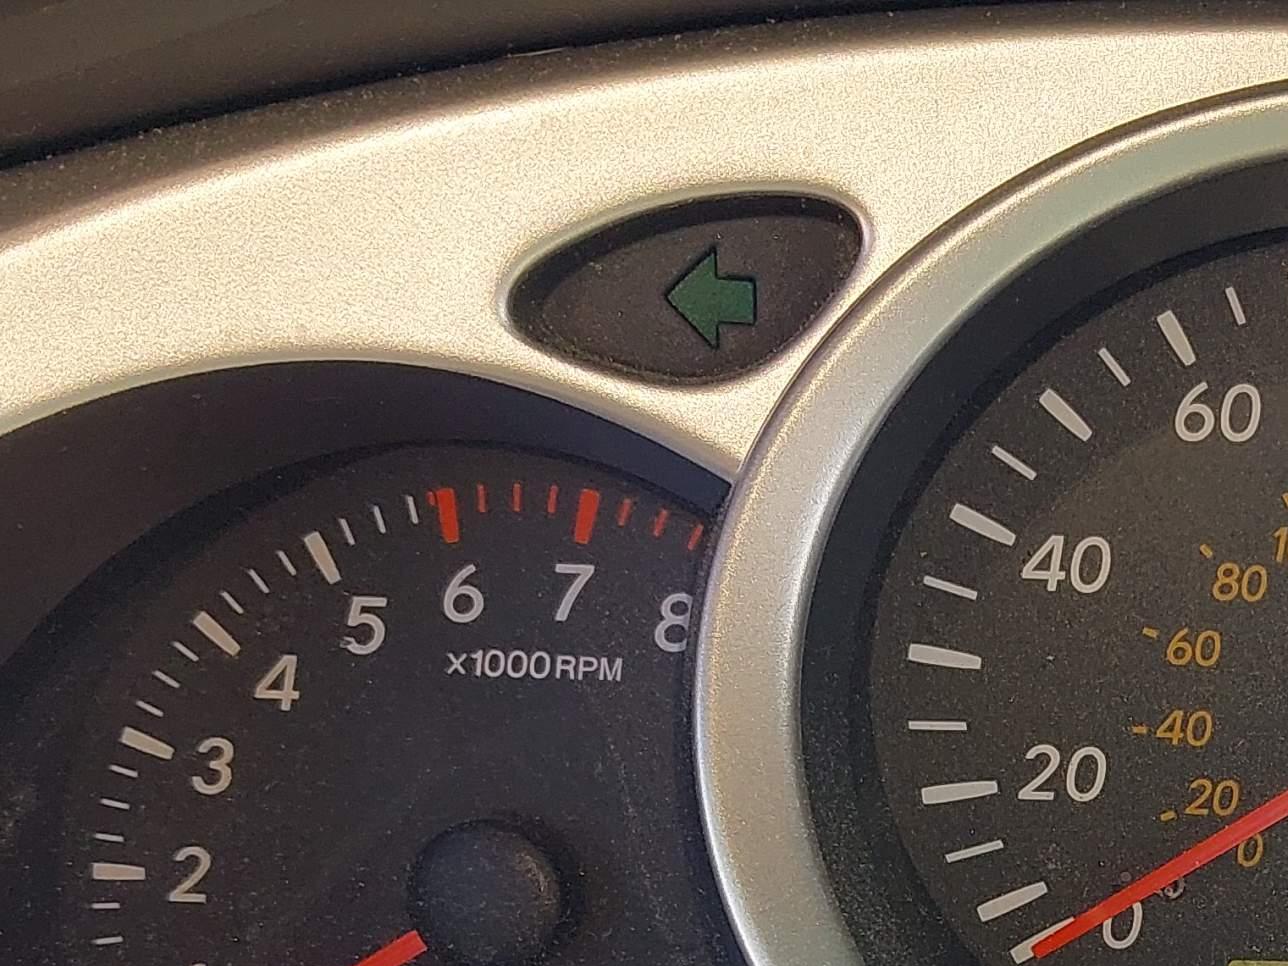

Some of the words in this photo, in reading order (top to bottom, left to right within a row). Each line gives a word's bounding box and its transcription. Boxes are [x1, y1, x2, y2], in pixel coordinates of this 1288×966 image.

[1174, 381, 1262, 443] 60
[554, 563, 595, 622] 7
[1020, 534, 1112, 594] 40
[1210, 560, 1269, 604] 80
[443, 563, 484, 623] 6
[341, 596, 388, 655] 5
[654, 592, 693, 653] 8
[1166, 628, 1223, 668] 60
[253, 654, 300, 711] 4
[555, 655, 623, 682] RPM
[1154, 708, 1214, 748] 40
[191, 737, 234, 795] 3
[1017, 744, 1107, 802] 20
[1183, 778, 1241, 817] 20
[168, 846, 211, 903] 2
[1236, 832, 1264, 868] 0
[1102, 901, 1143, 950] 0
